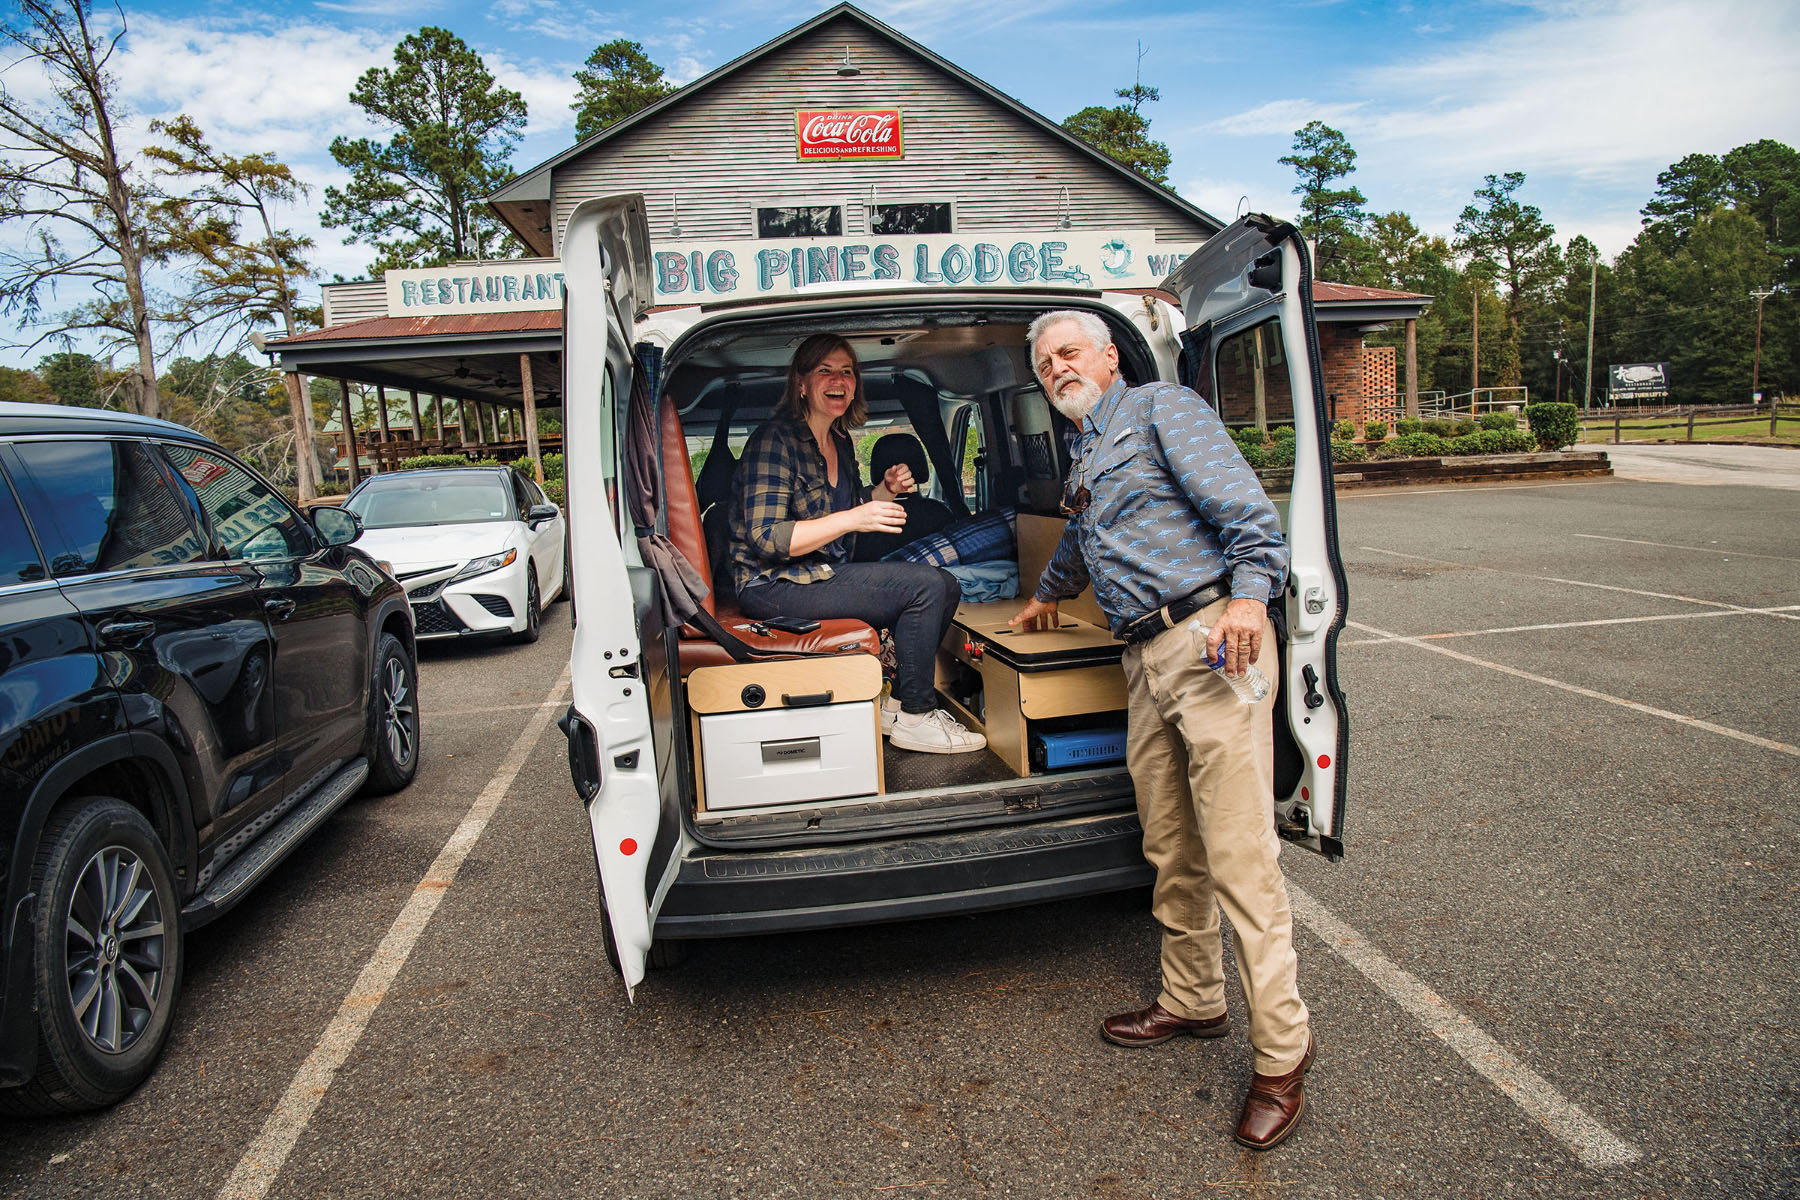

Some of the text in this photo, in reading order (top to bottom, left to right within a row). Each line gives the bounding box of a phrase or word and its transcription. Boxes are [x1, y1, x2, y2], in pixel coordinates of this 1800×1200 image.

[802, 114, 896, 144] Coca-Cola
[653, 241, 1068, 296] BIG PINES LODGE
[783, 748, 806, 756] DOMETIC
